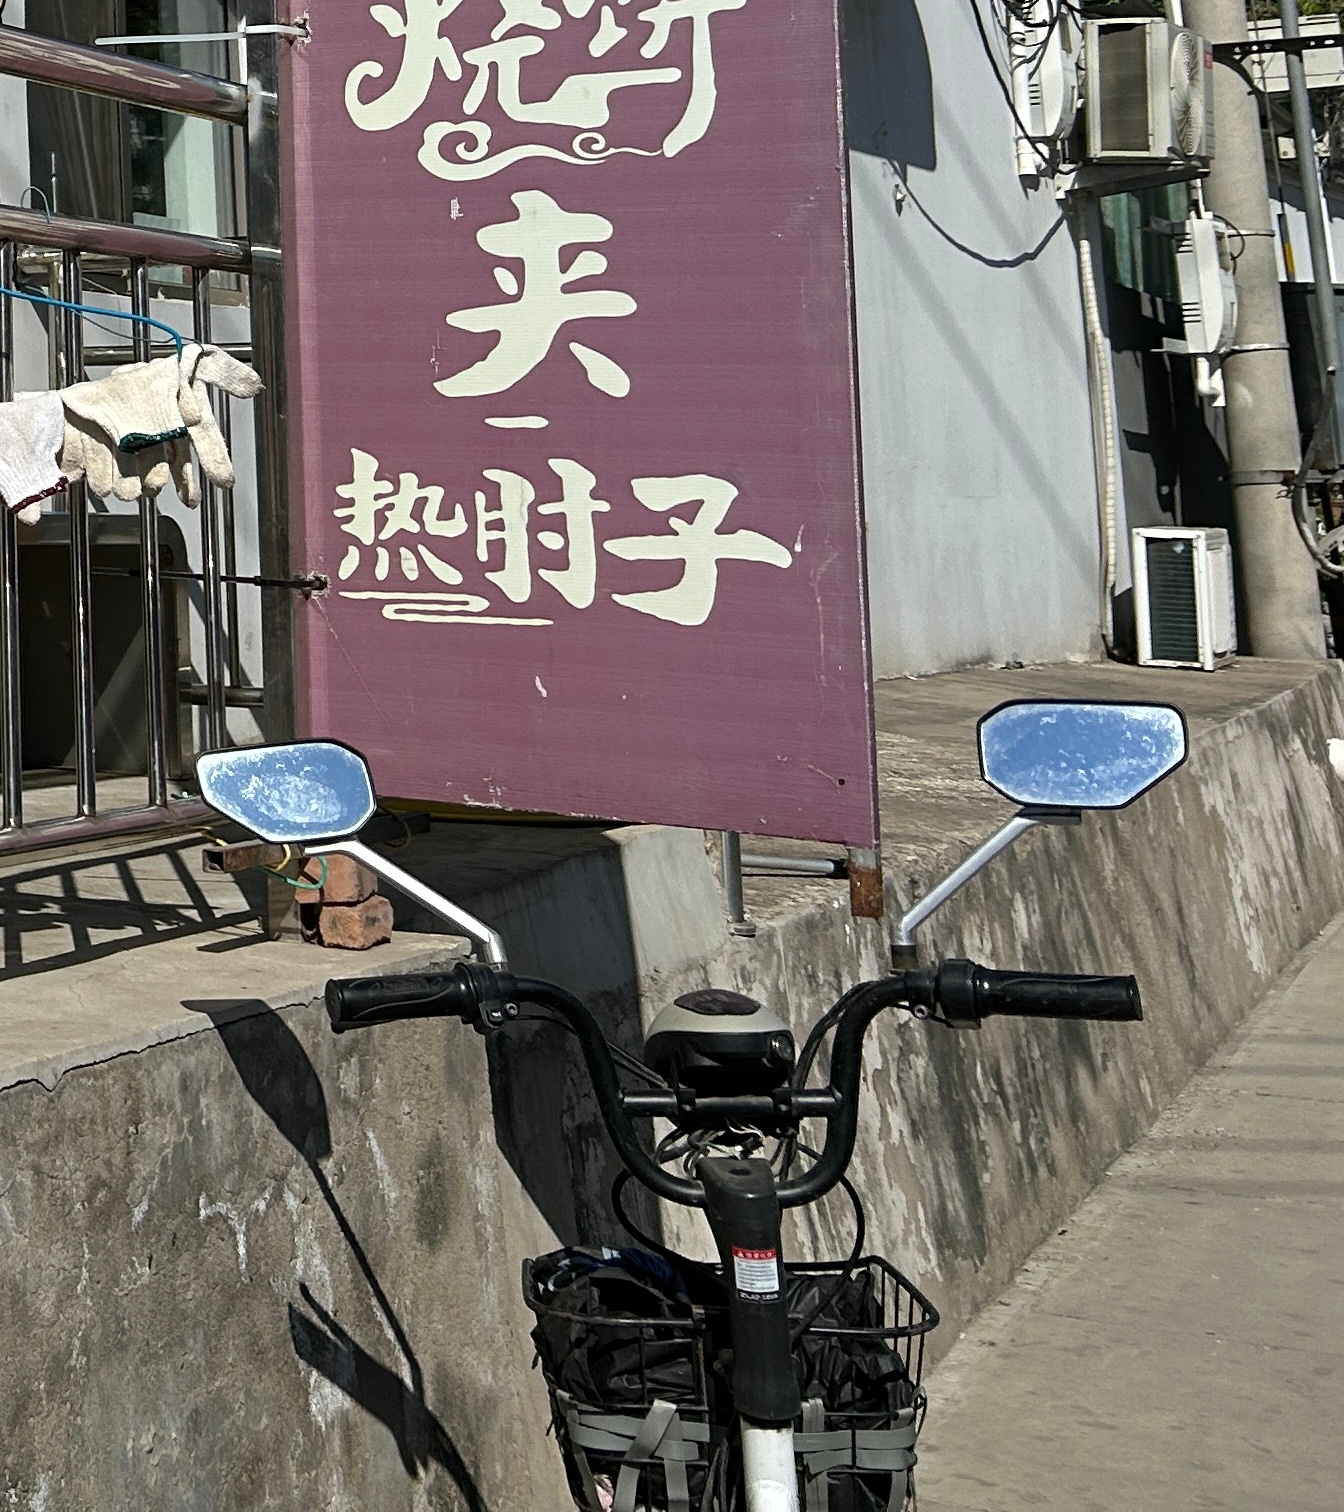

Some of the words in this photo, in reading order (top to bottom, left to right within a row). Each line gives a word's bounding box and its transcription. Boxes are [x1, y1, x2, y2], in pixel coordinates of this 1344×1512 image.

[433, 189, 637, 399] 夹
[334, 446, 792, 626] 热肘子
